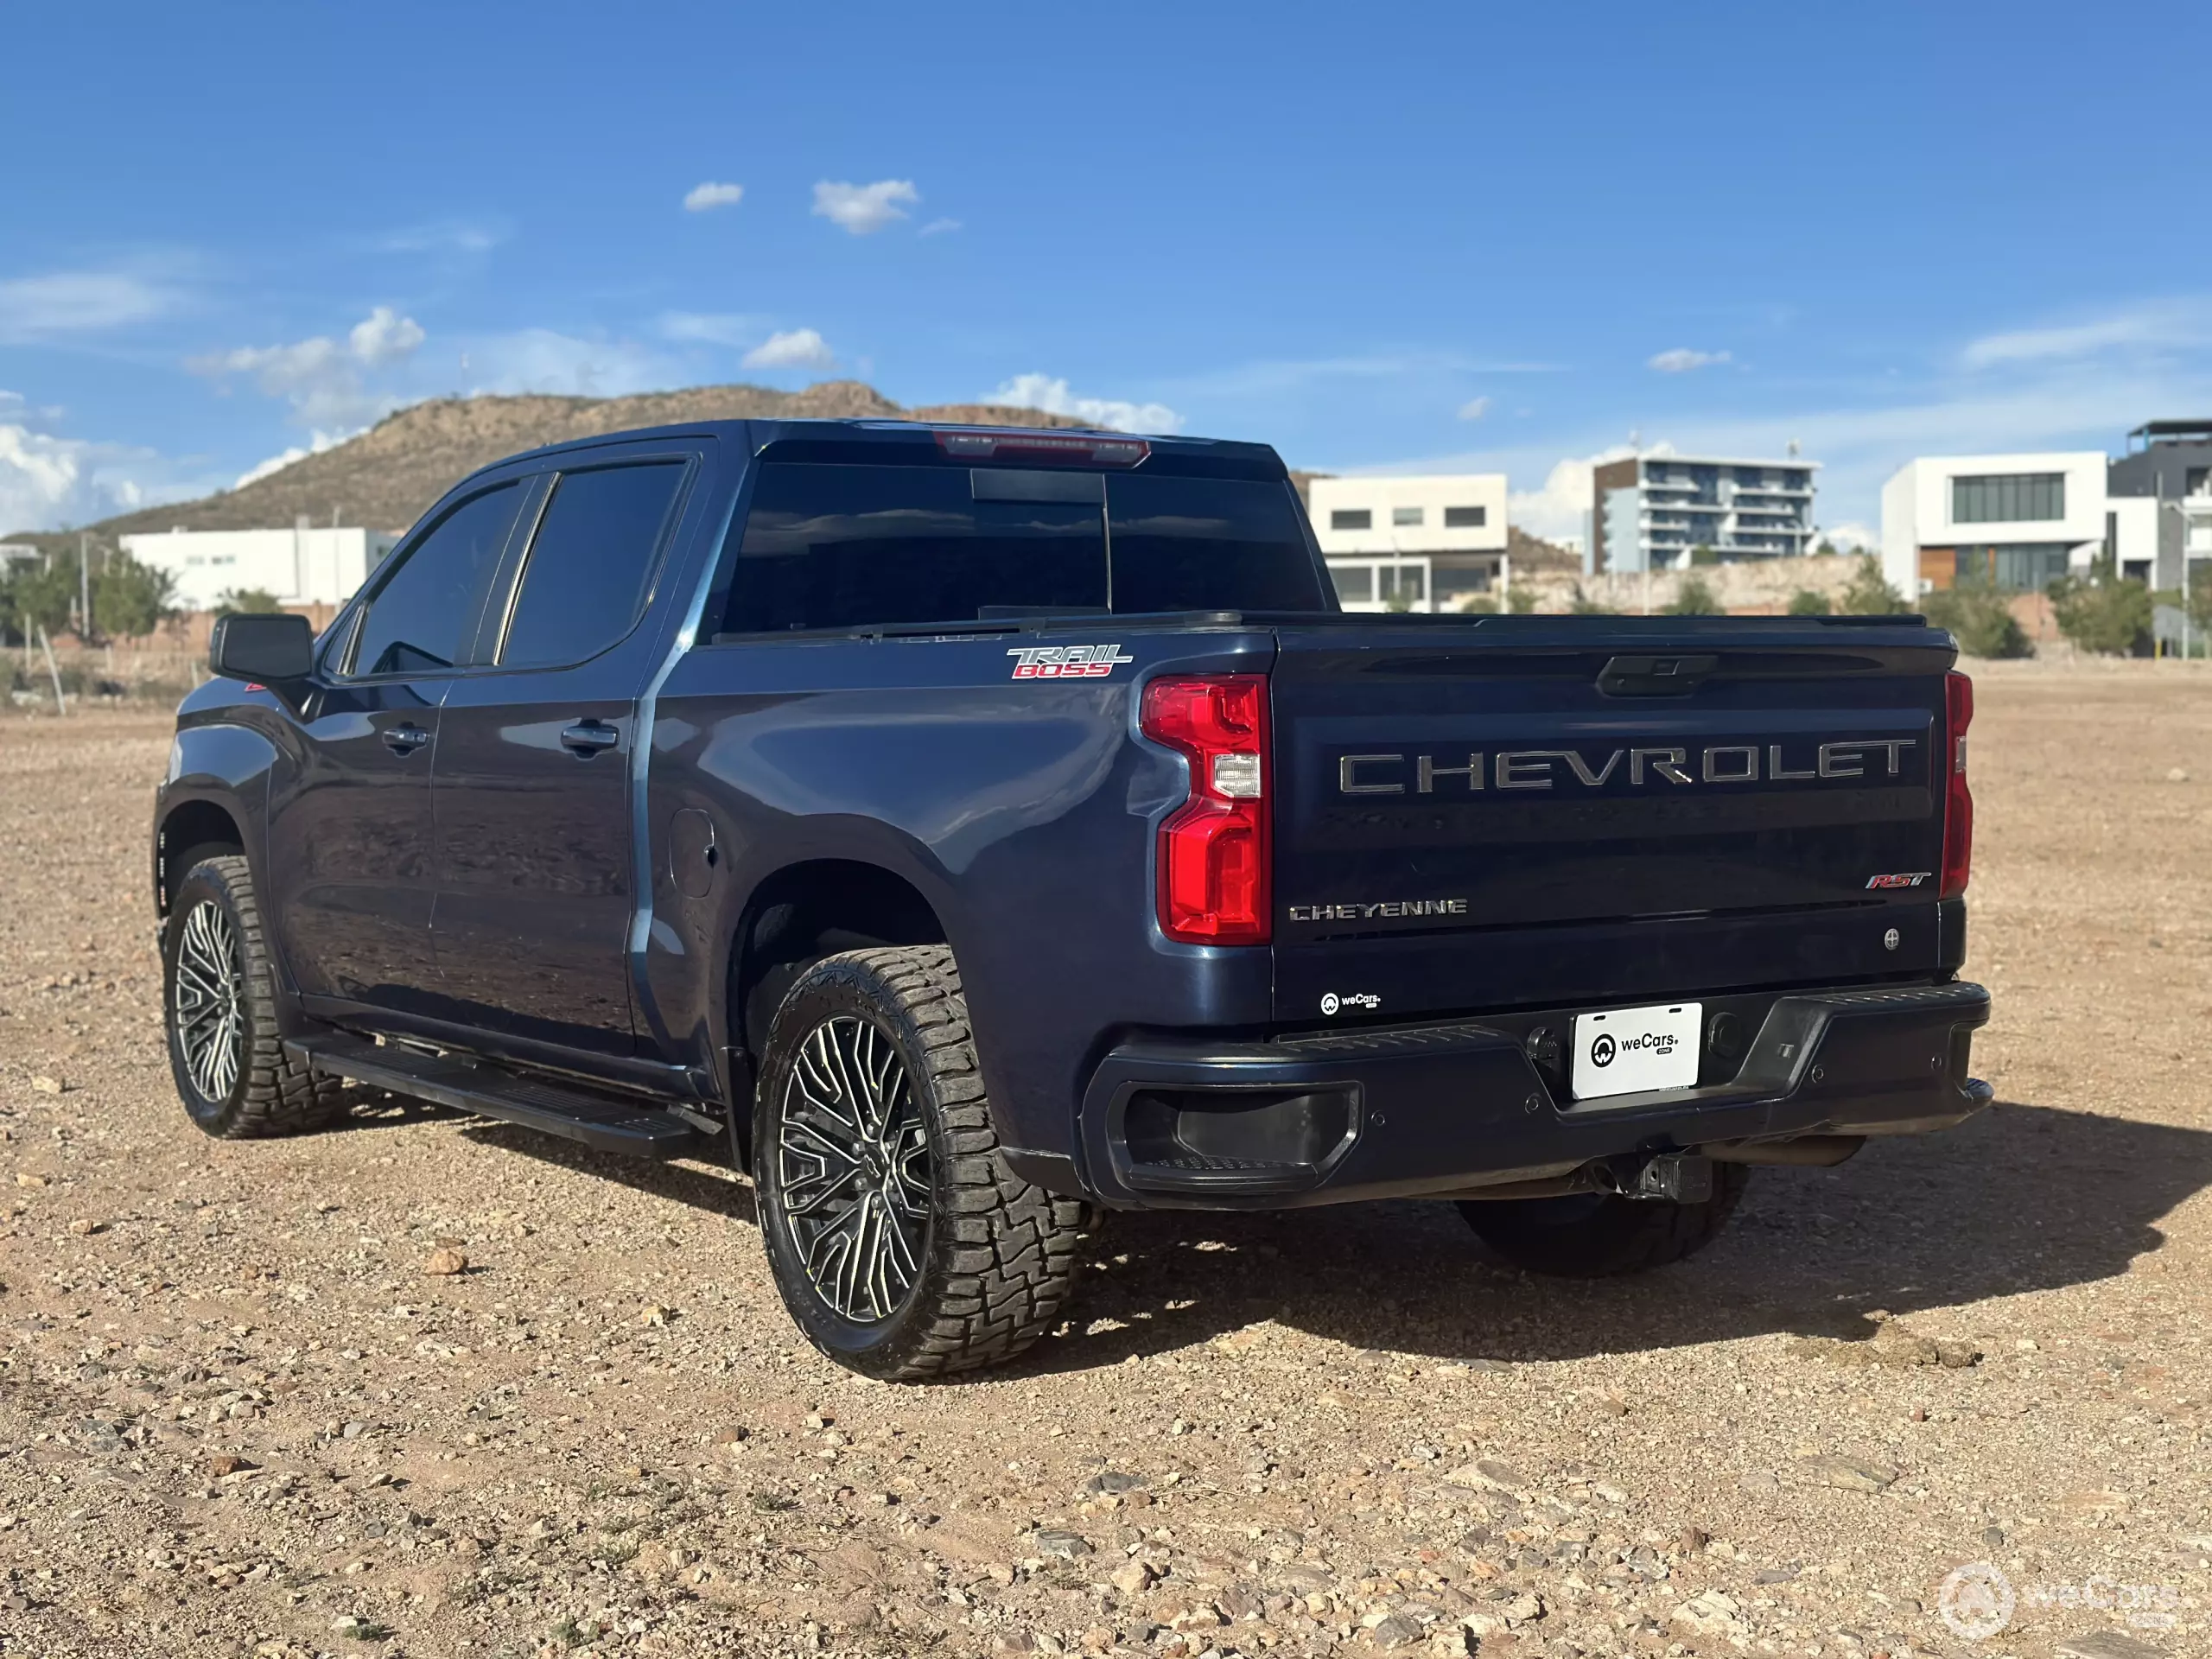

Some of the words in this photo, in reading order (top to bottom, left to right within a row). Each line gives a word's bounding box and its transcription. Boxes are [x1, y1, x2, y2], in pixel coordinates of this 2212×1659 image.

[1007, 644, 1134, 664] TRAIL
[1012, 662, 1113, 679] BOSS
[1340, 739, 1916, 794] CHEVROLET
[1866, 872, 1932, 889] RST
[1289, 899, 1468, 922] CHEYENNE
